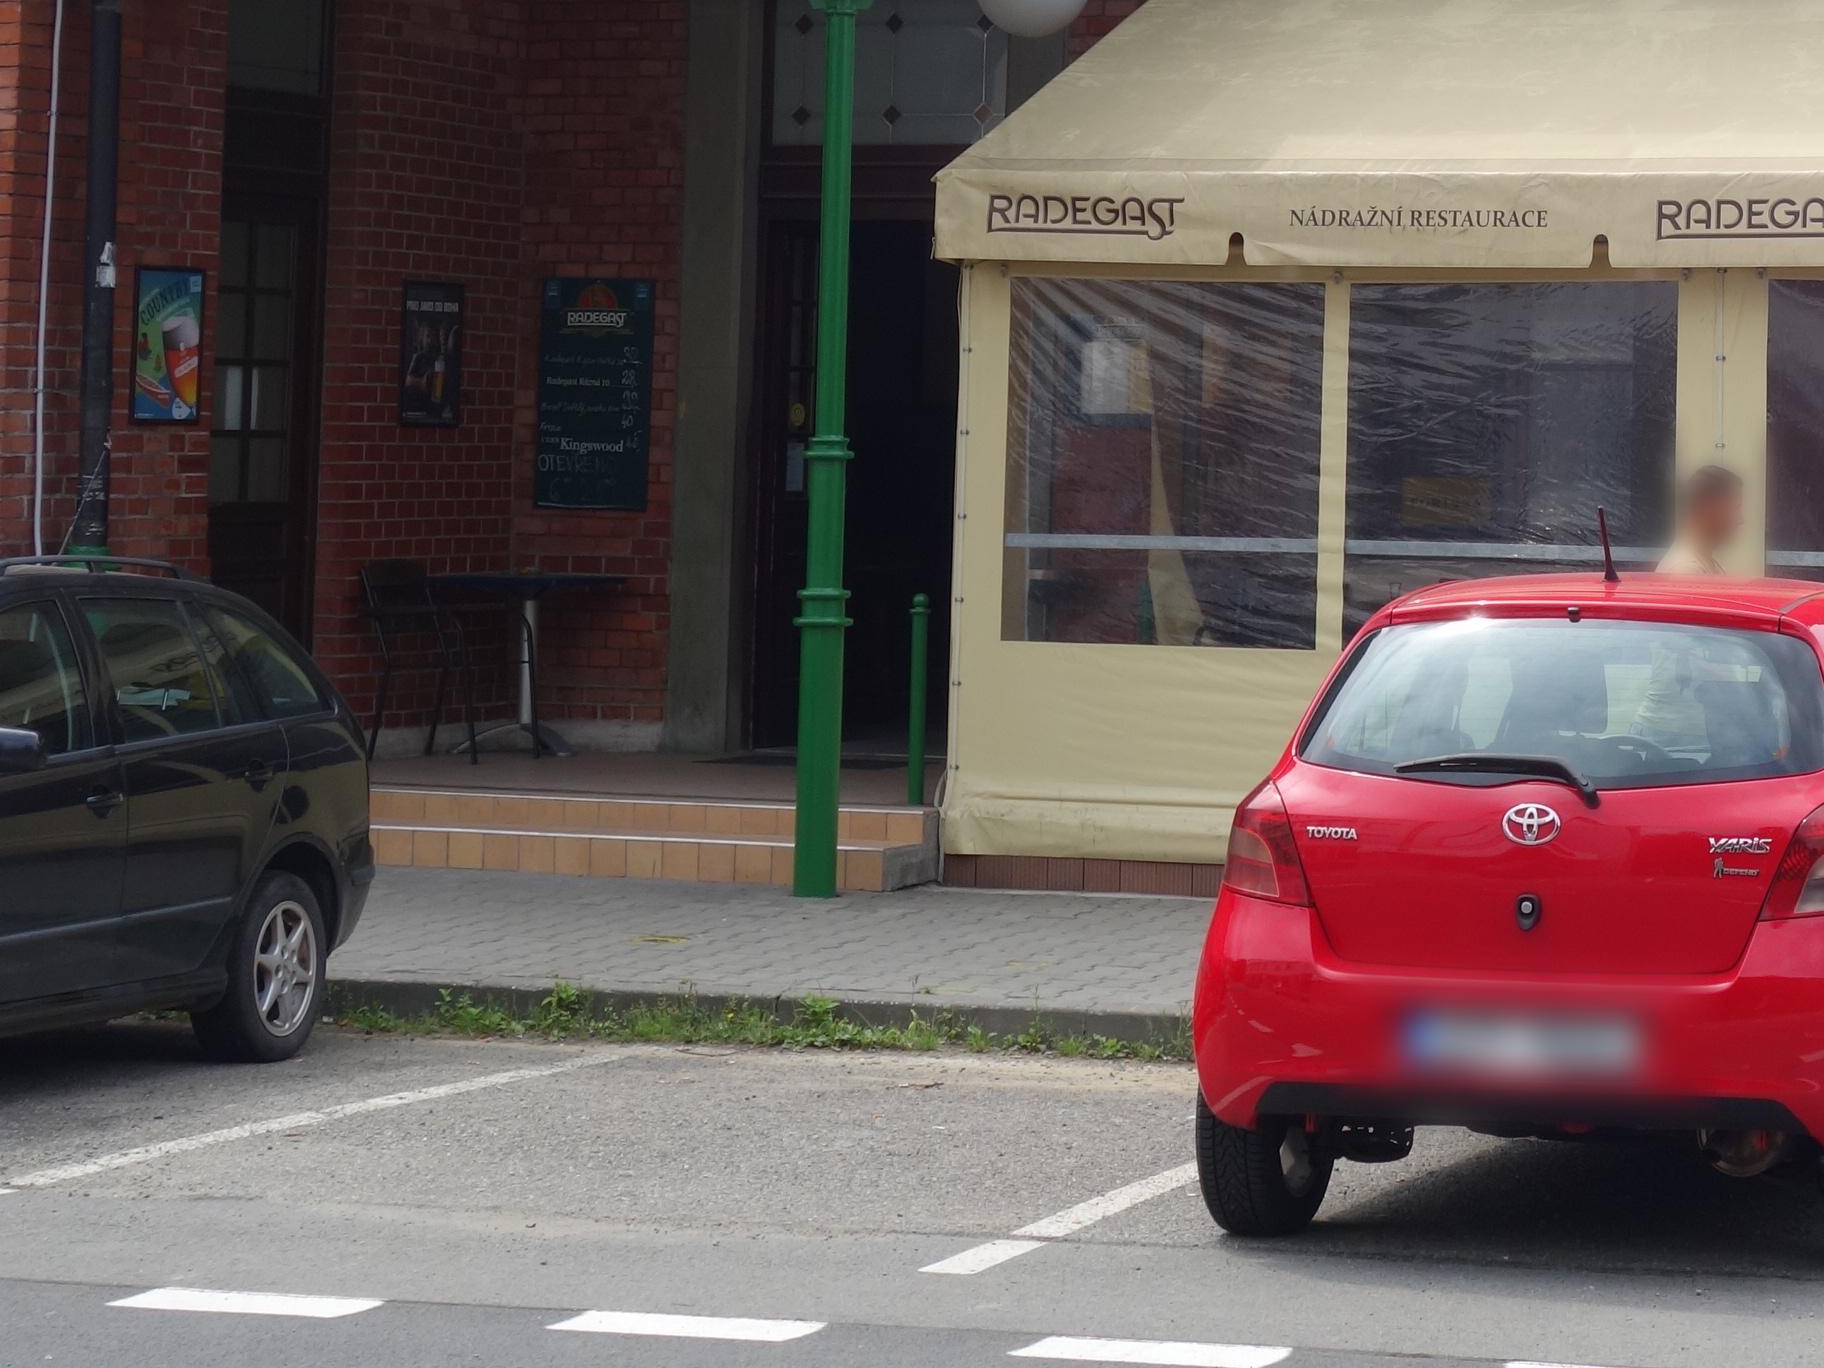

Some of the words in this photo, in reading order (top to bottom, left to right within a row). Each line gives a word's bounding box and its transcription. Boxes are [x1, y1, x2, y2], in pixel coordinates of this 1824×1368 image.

[986, 193, 1185, 241] RADEGAST
[1289, 203, 1405, 229] NÁDRAŽNÍ
[1409, 208, 1549, 230] RESTAURACE
[567, 311, 628, 328] RADEGAST
[560, 436, 625, 455] Kingswood
[1306, 826, 1358, 840] TOYOTA
